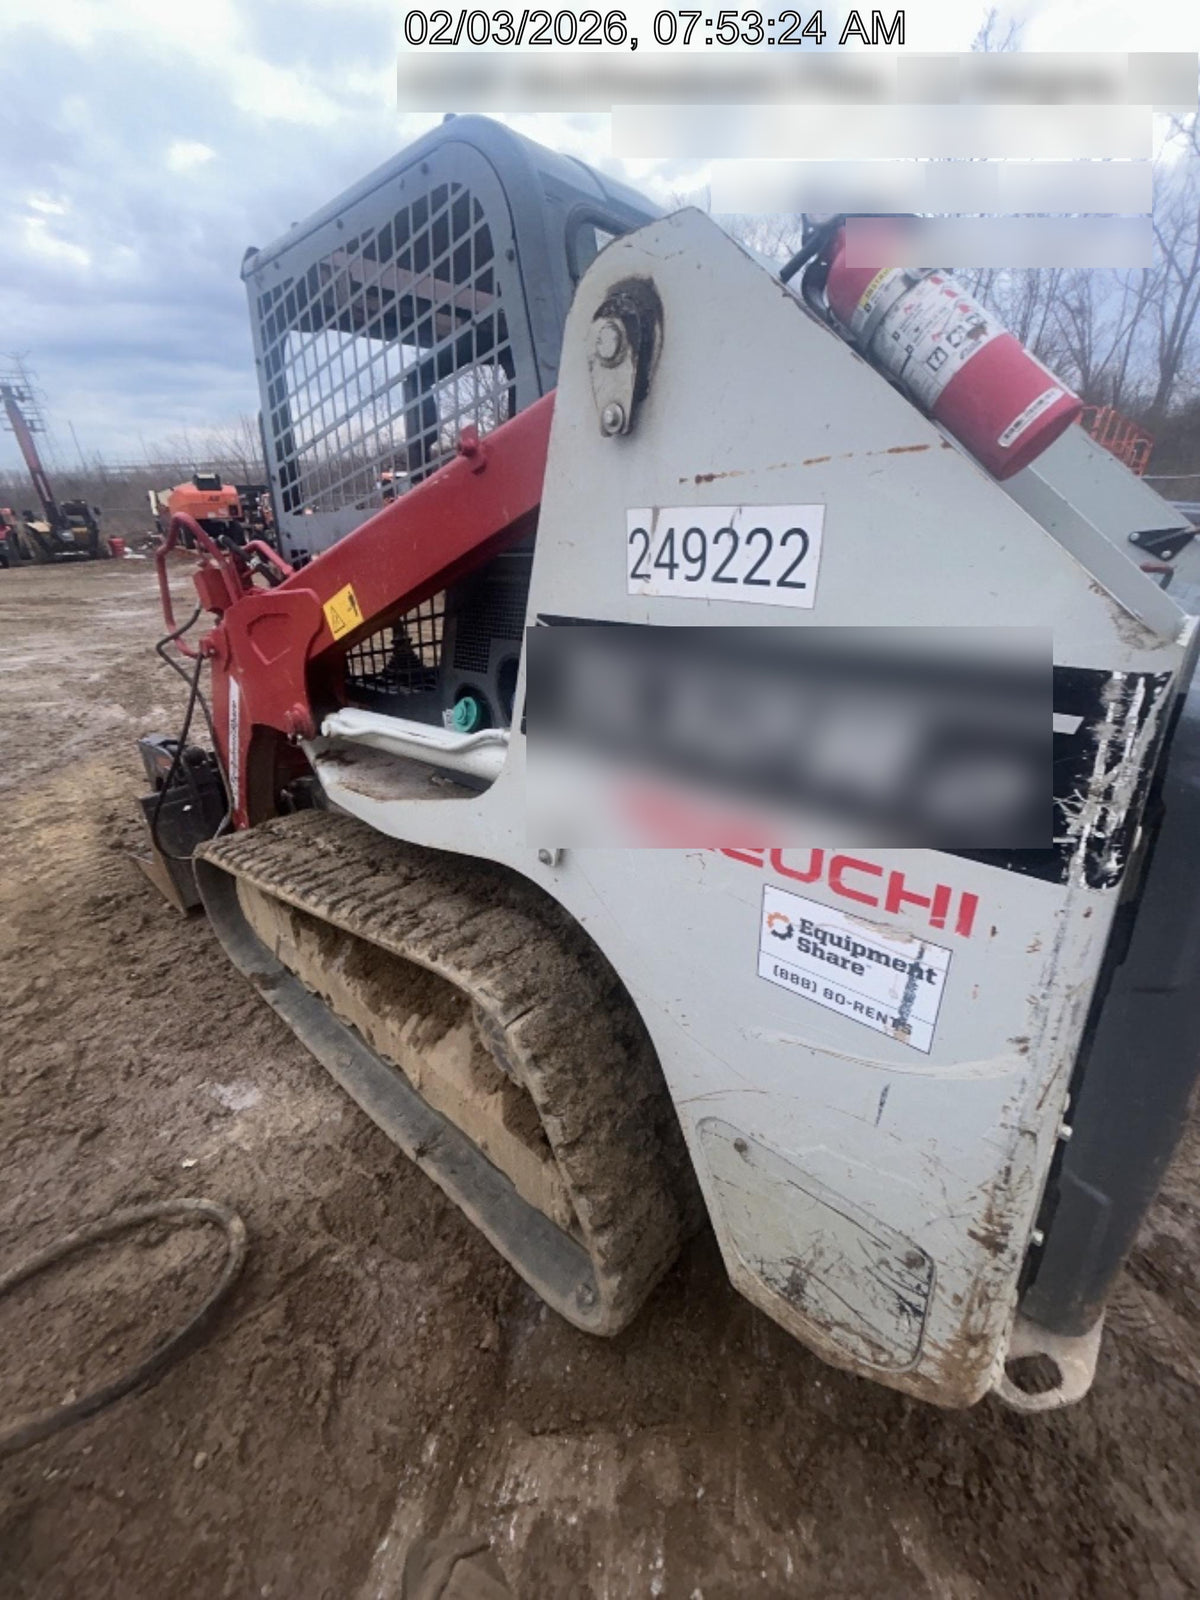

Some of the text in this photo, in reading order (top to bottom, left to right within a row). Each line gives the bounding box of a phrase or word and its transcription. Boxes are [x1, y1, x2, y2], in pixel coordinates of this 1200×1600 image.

[628, 527, 810, 589] 249222
[797, 936, 866, 976] Share
[799, 917, 938, 986] Equipment
[773, 964, 817, 993] (888)
